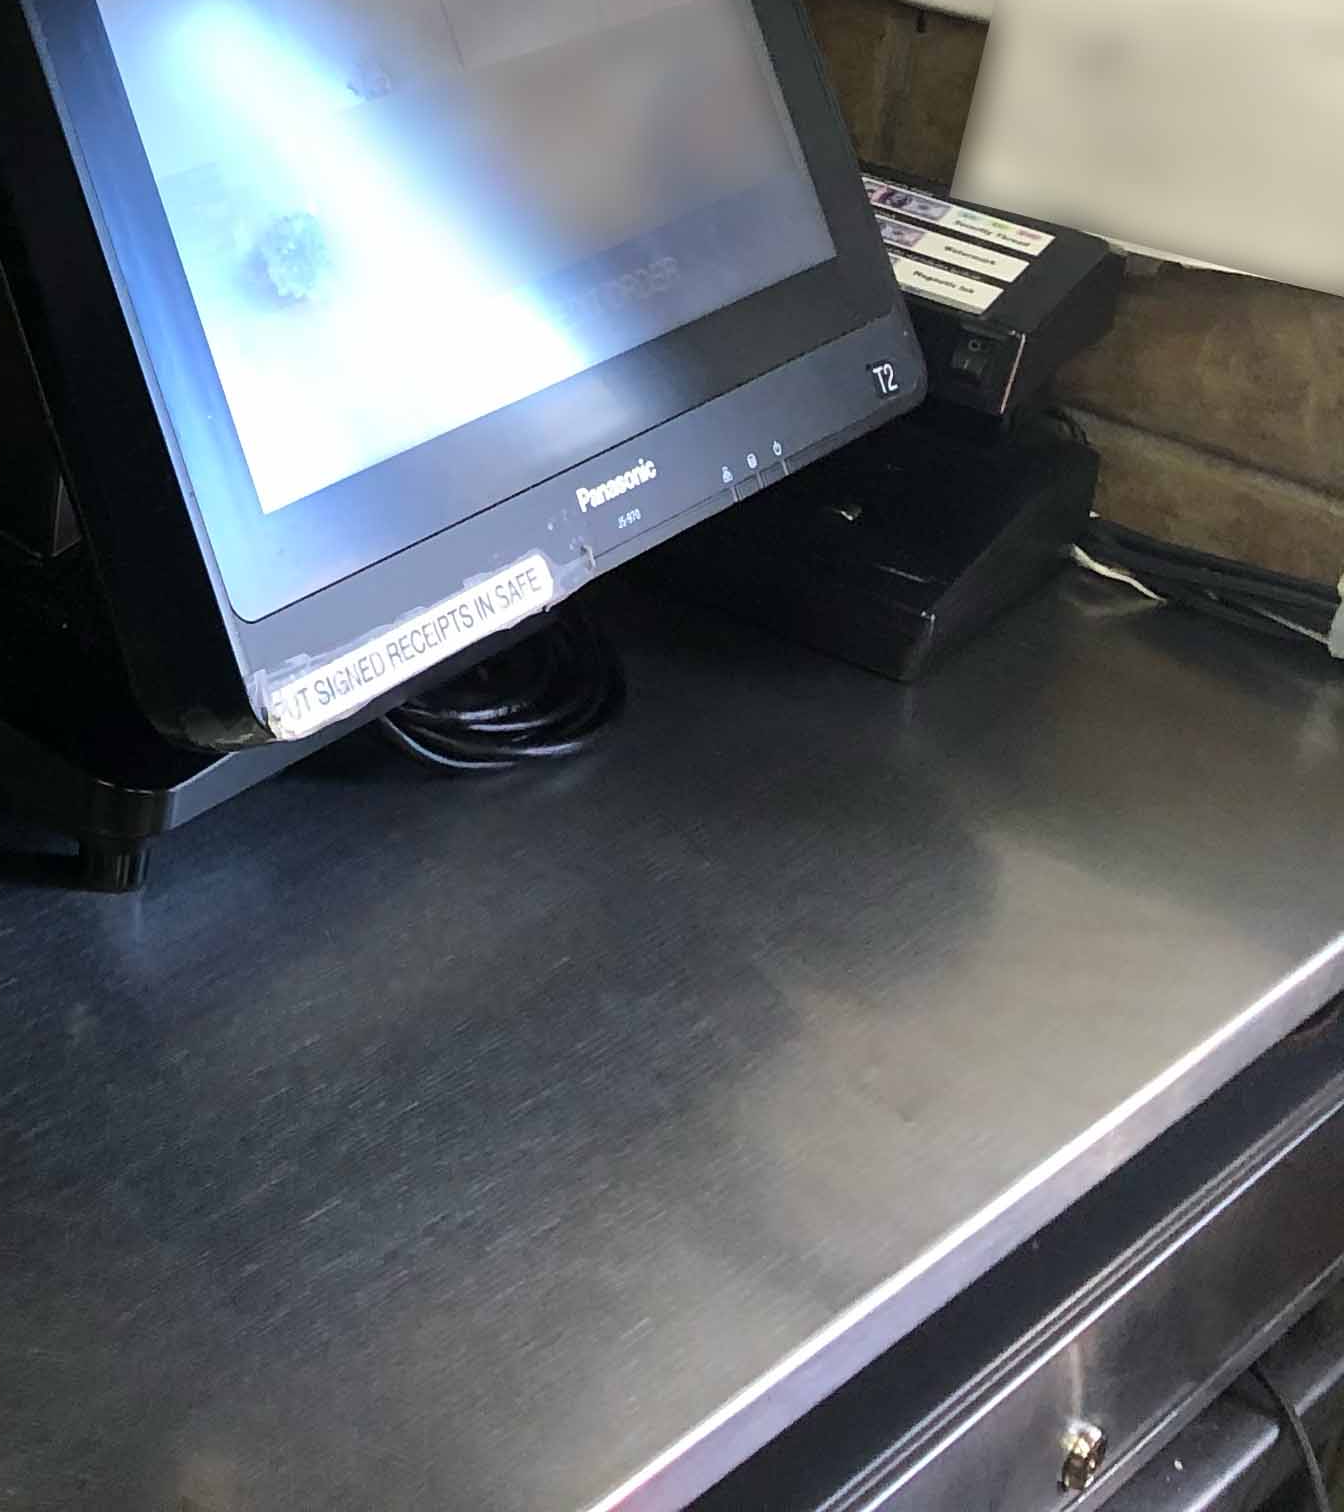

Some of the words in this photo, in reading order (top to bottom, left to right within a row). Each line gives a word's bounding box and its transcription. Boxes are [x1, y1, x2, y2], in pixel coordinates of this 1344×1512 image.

[872, 361, 899, 397] T2
[576, 458, 657, 513] Panasonic
[315, 651, 386, 705] SIGNED
[387, 604, 475, 669] RECEIPTS
[475, 595, 496, 622] IN
[496, 567, 543, 610] SAFE
